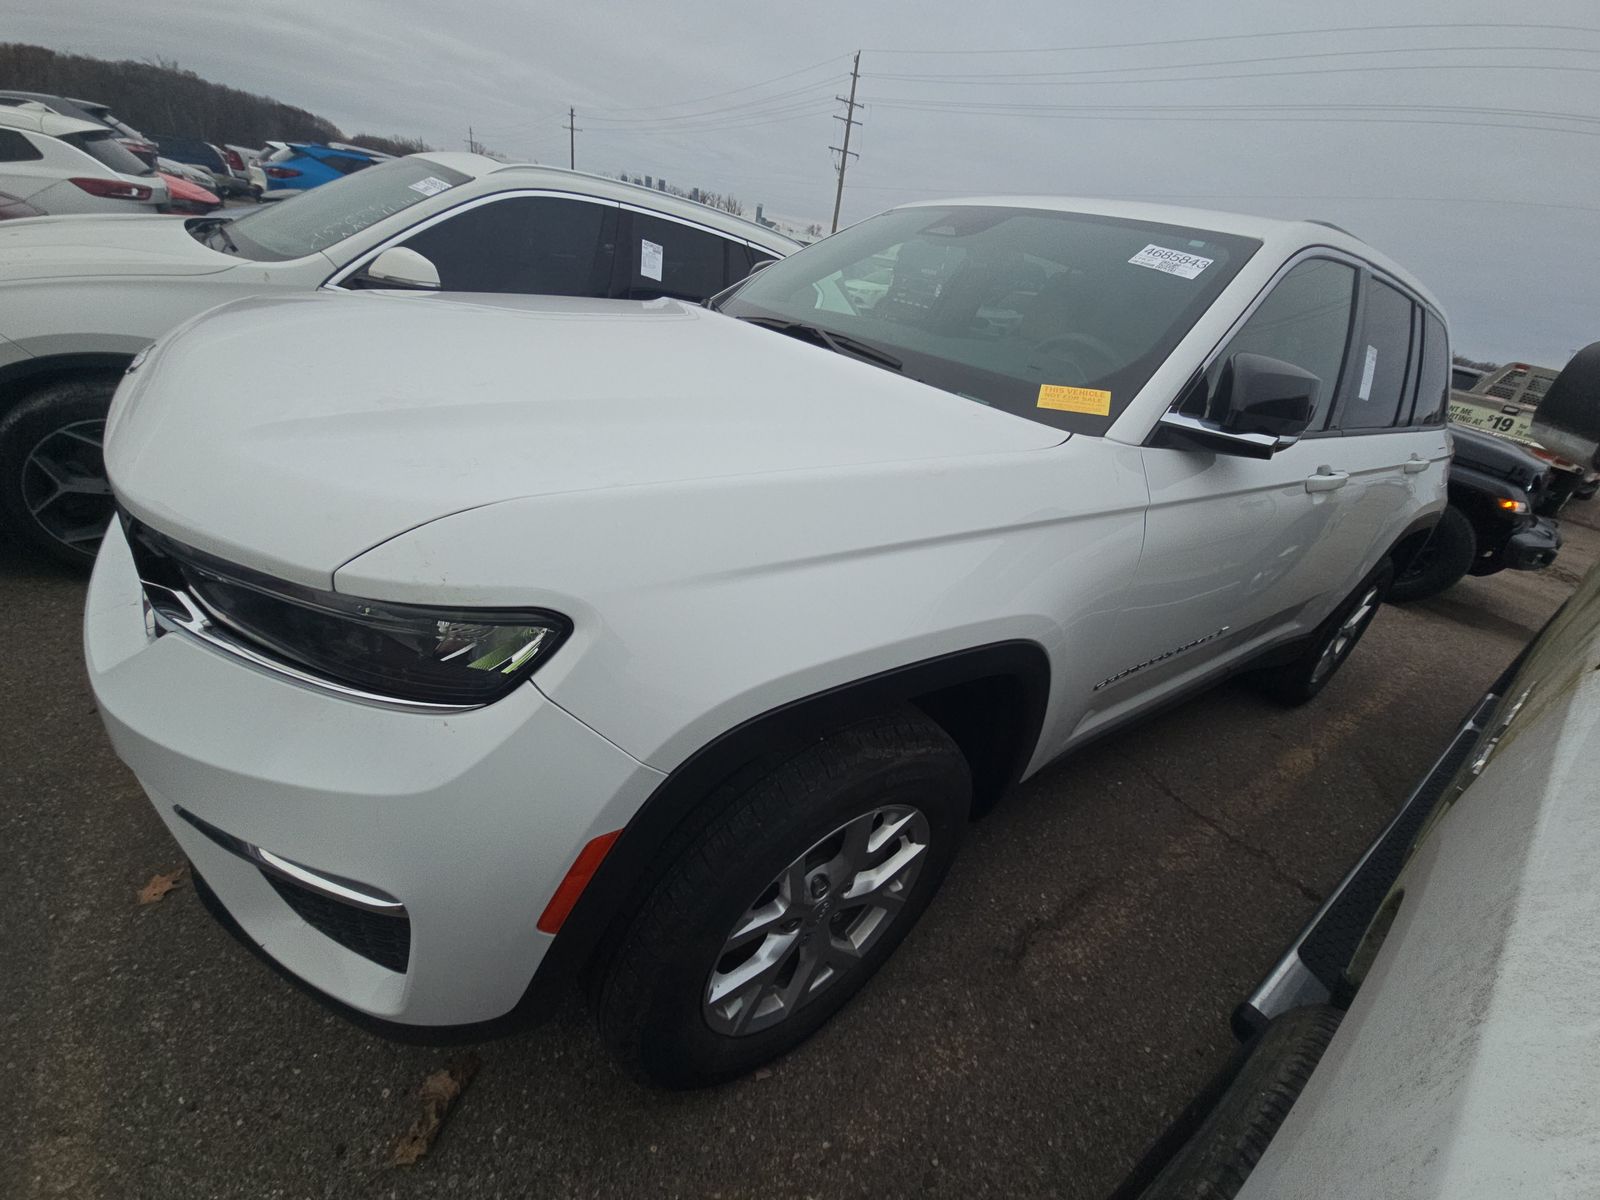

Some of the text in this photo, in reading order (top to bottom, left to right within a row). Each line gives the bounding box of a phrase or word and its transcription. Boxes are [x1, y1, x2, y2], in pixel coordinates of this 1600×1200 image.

[1144, 247, 1210, 270] 4685843
[1043, 386, 1105, 398] THIS VEHICLE
[1460, 407, 1473, 416] ME
[1472, 418, 1484, 426] AT
[1487, 414, 1515, 432] $19
